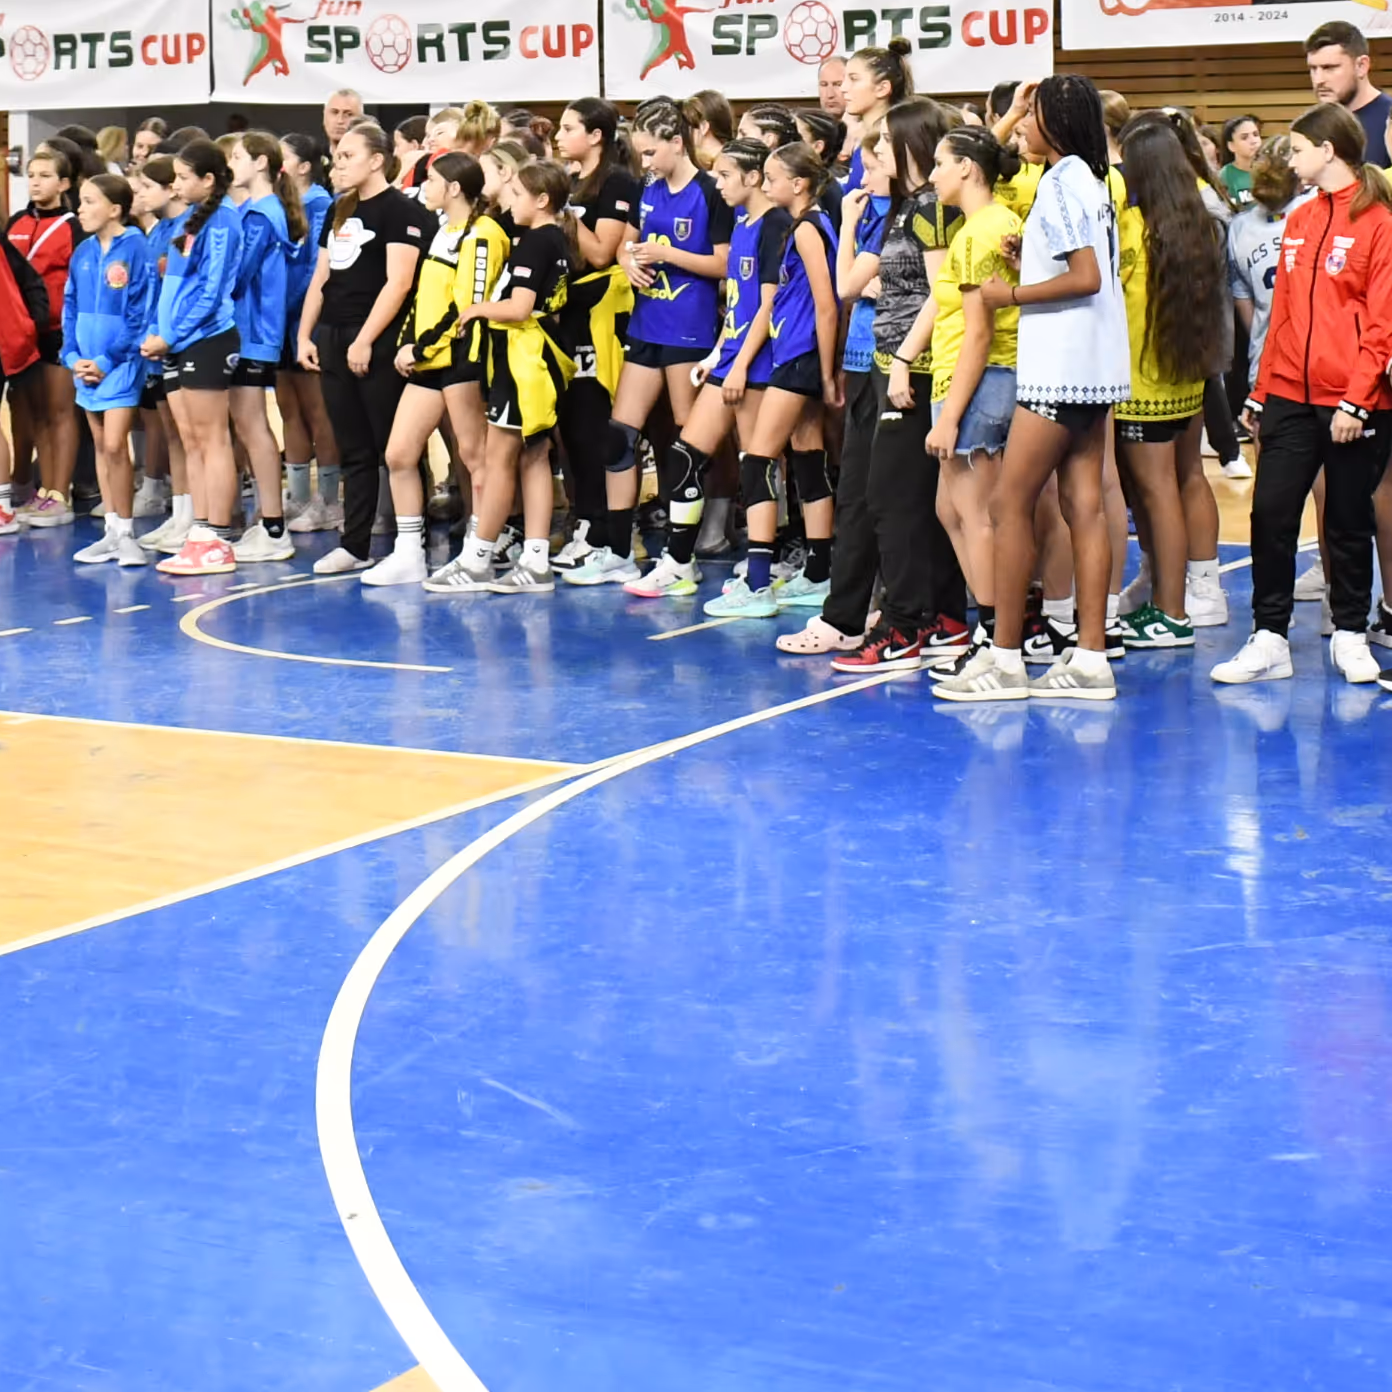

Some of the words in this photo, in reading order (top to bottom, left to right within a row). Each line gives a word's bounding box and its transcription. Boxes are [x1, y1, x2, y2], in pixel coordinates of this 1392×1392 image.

[961, 8, 1050, 48] CUP
[1214, 12, 1245, 23] 2014
[1258, 10, 1289, 21] 2024
[140, 32, 207, 66] CUP
[518, 23, 595, 59] CUP
